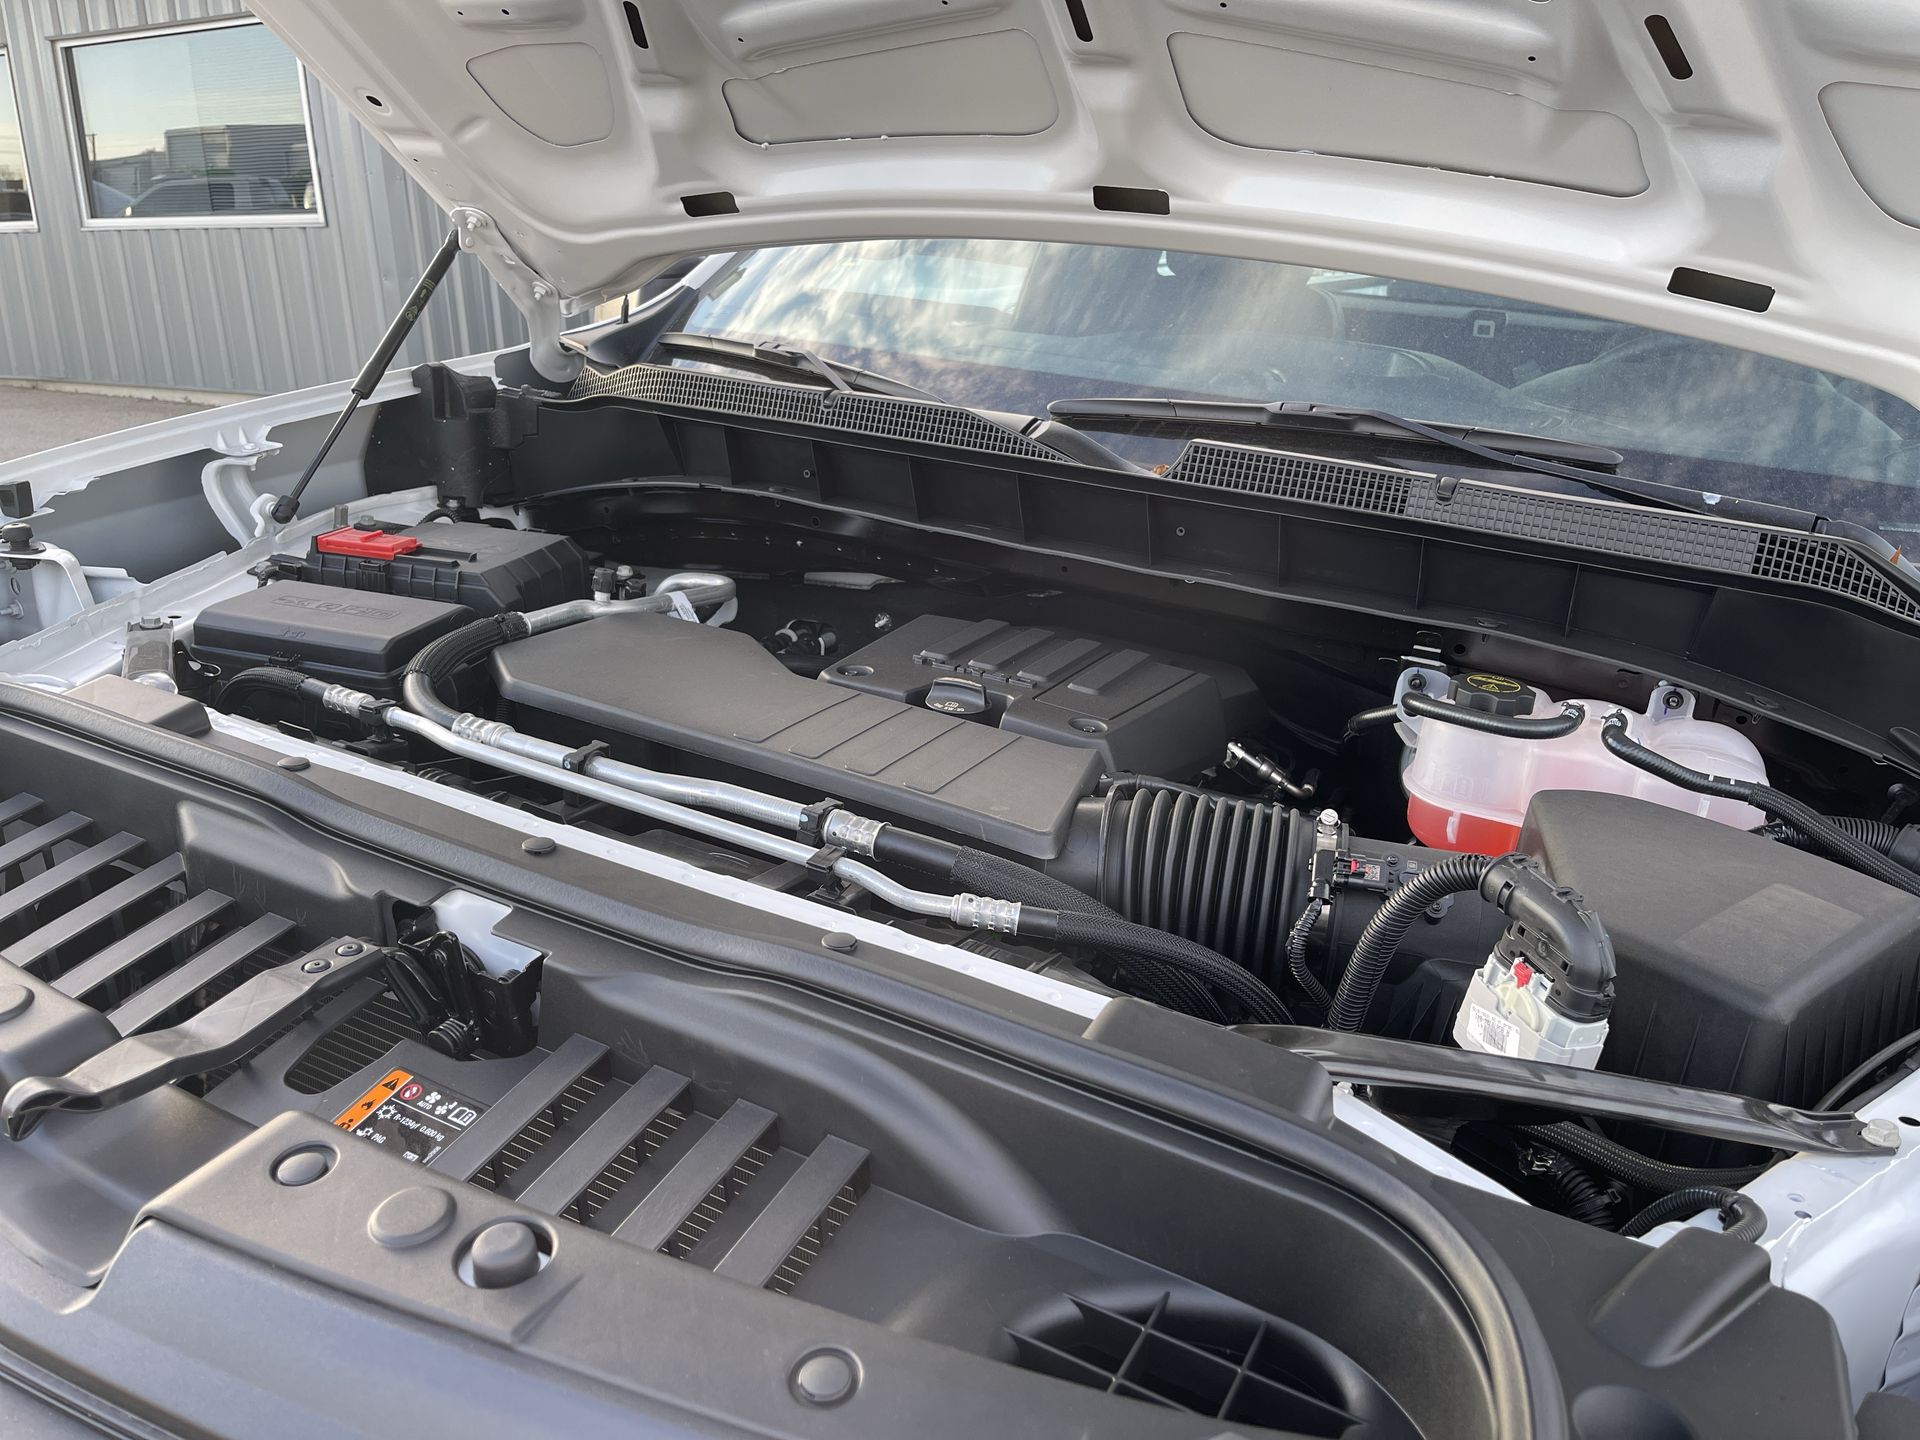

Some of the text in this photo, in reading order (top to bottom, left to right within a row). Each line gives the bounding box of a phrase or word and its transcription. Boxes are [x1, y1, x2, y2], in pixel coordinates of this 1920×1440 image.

[416, 1100, 433, 1110] AUTO
[393, 1113, 421, 1130] R-1234yf
[434, 1132, 445, 1142] kg
[370, 1133, 387, 1144] PAG
